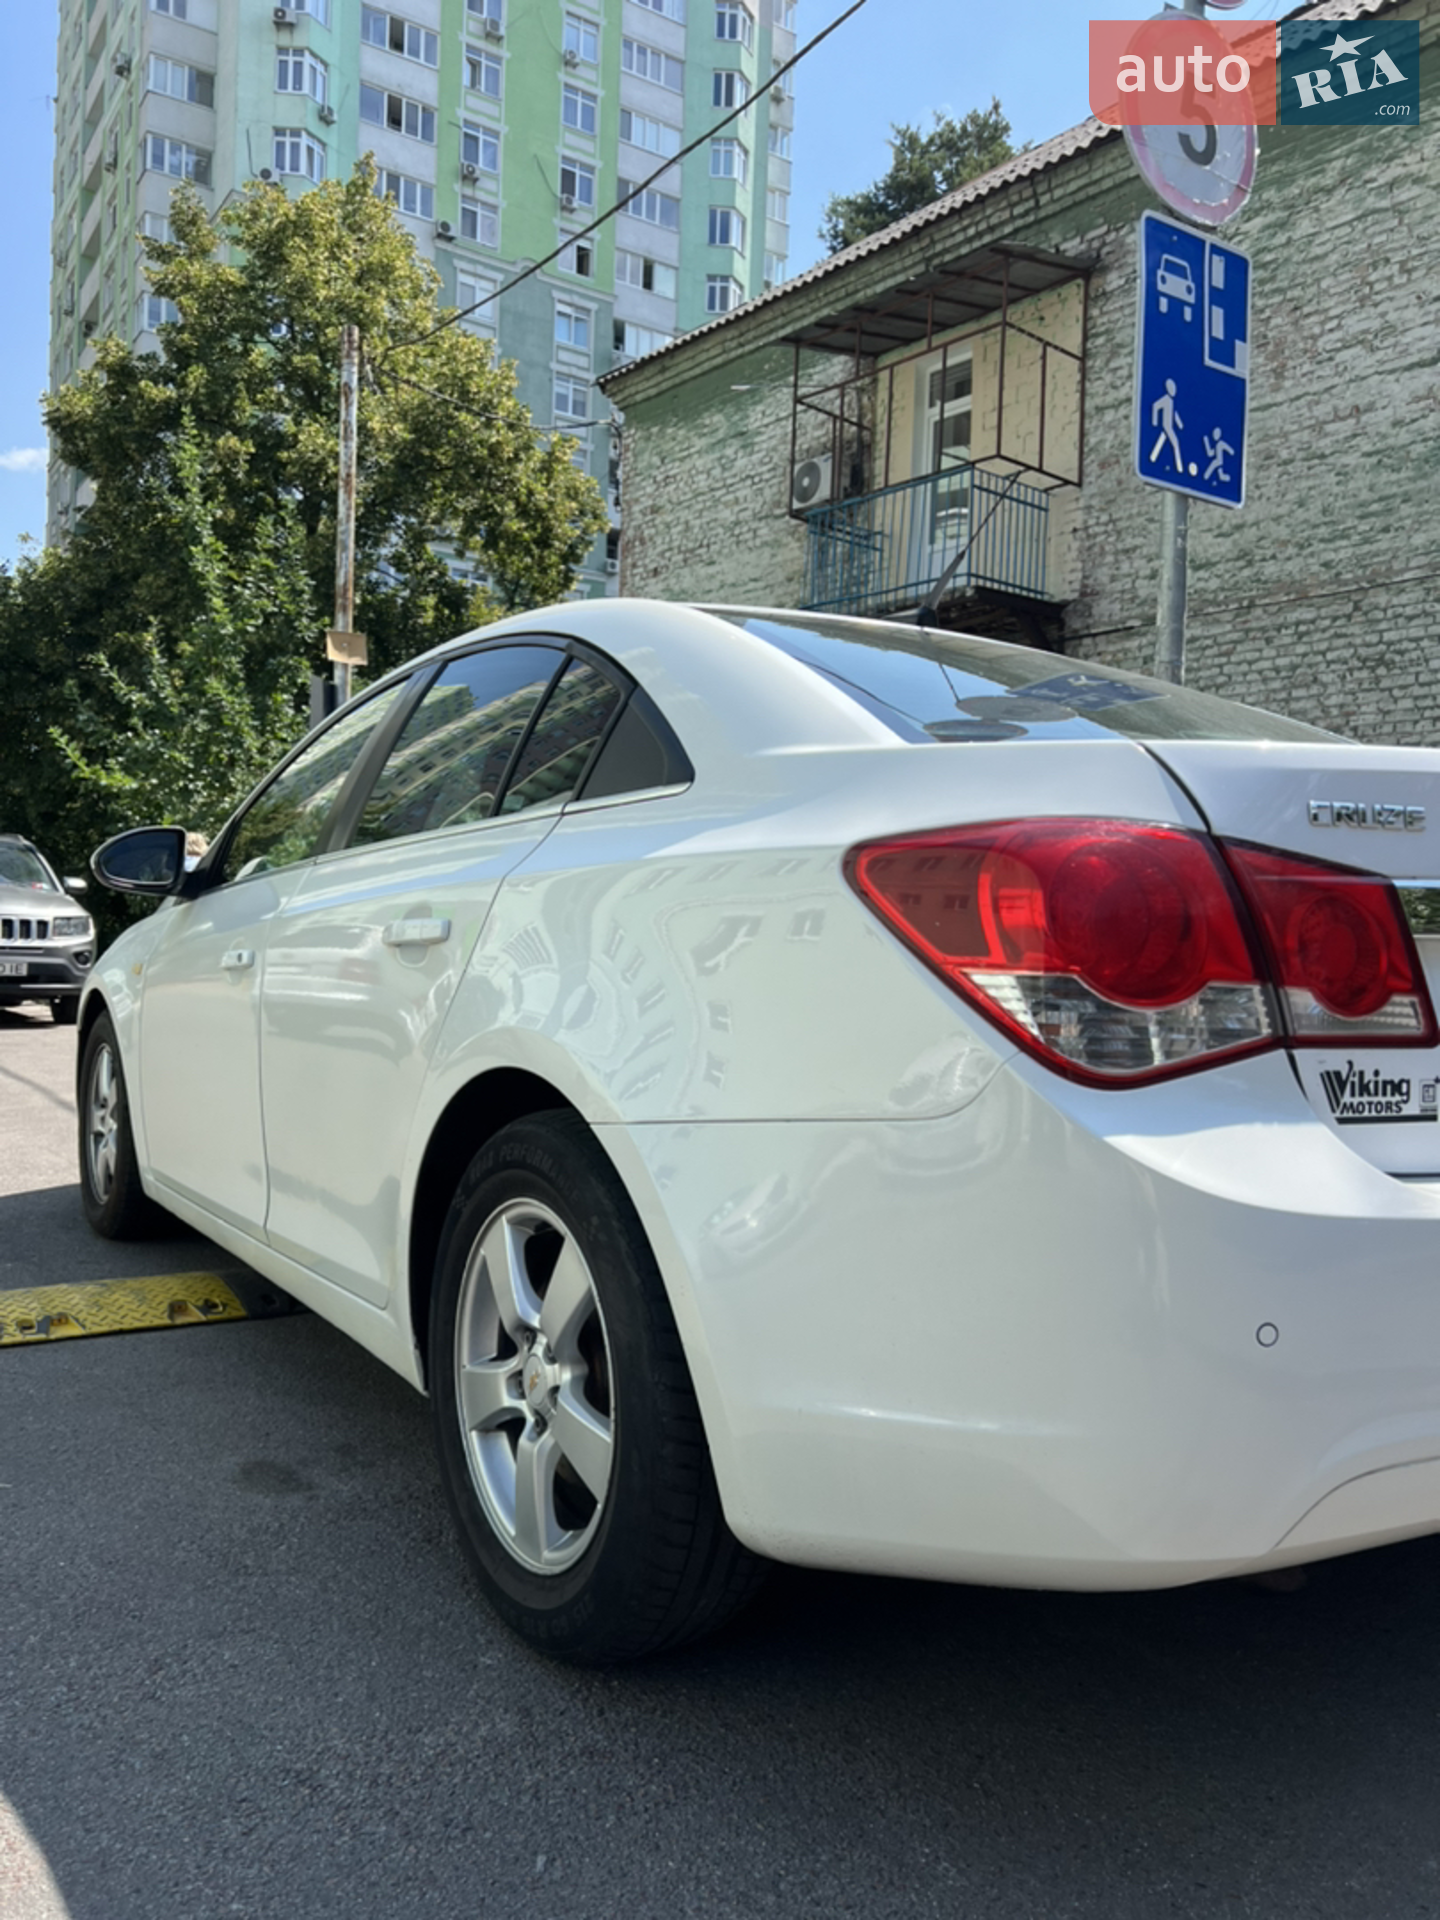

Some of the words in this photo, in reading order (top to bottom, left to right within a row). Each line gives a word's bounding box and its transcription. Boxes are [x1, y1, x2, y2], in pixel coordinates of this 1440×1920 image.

[1177, 70, 1218, 166] 5
[1307, 799, 1427, 832] CRUZE
[1319, 1059, 1411, 1114] Viking
[1340, 1101, 1404, 1115] MOTORS
